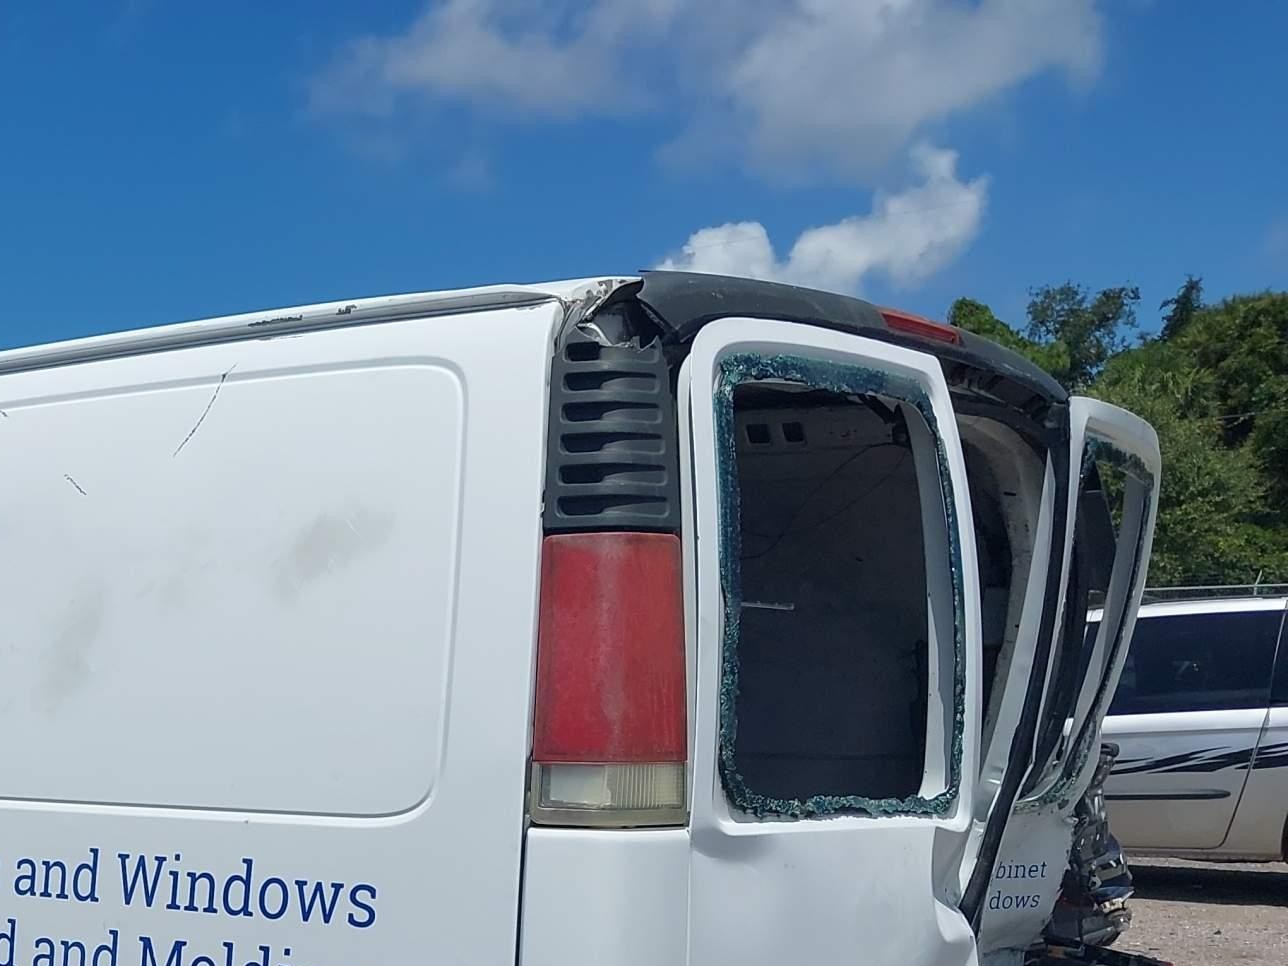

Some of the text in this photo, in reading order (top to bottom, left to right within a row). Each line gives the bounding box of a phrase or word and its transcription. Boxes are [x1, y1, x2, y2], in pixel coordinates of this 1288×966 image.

[995, 860, 1047, 879] binet
[14, 848, 99, 902] and
[118, 853, 377, 928] Windows
[989, 891, 1040, 909] dows
